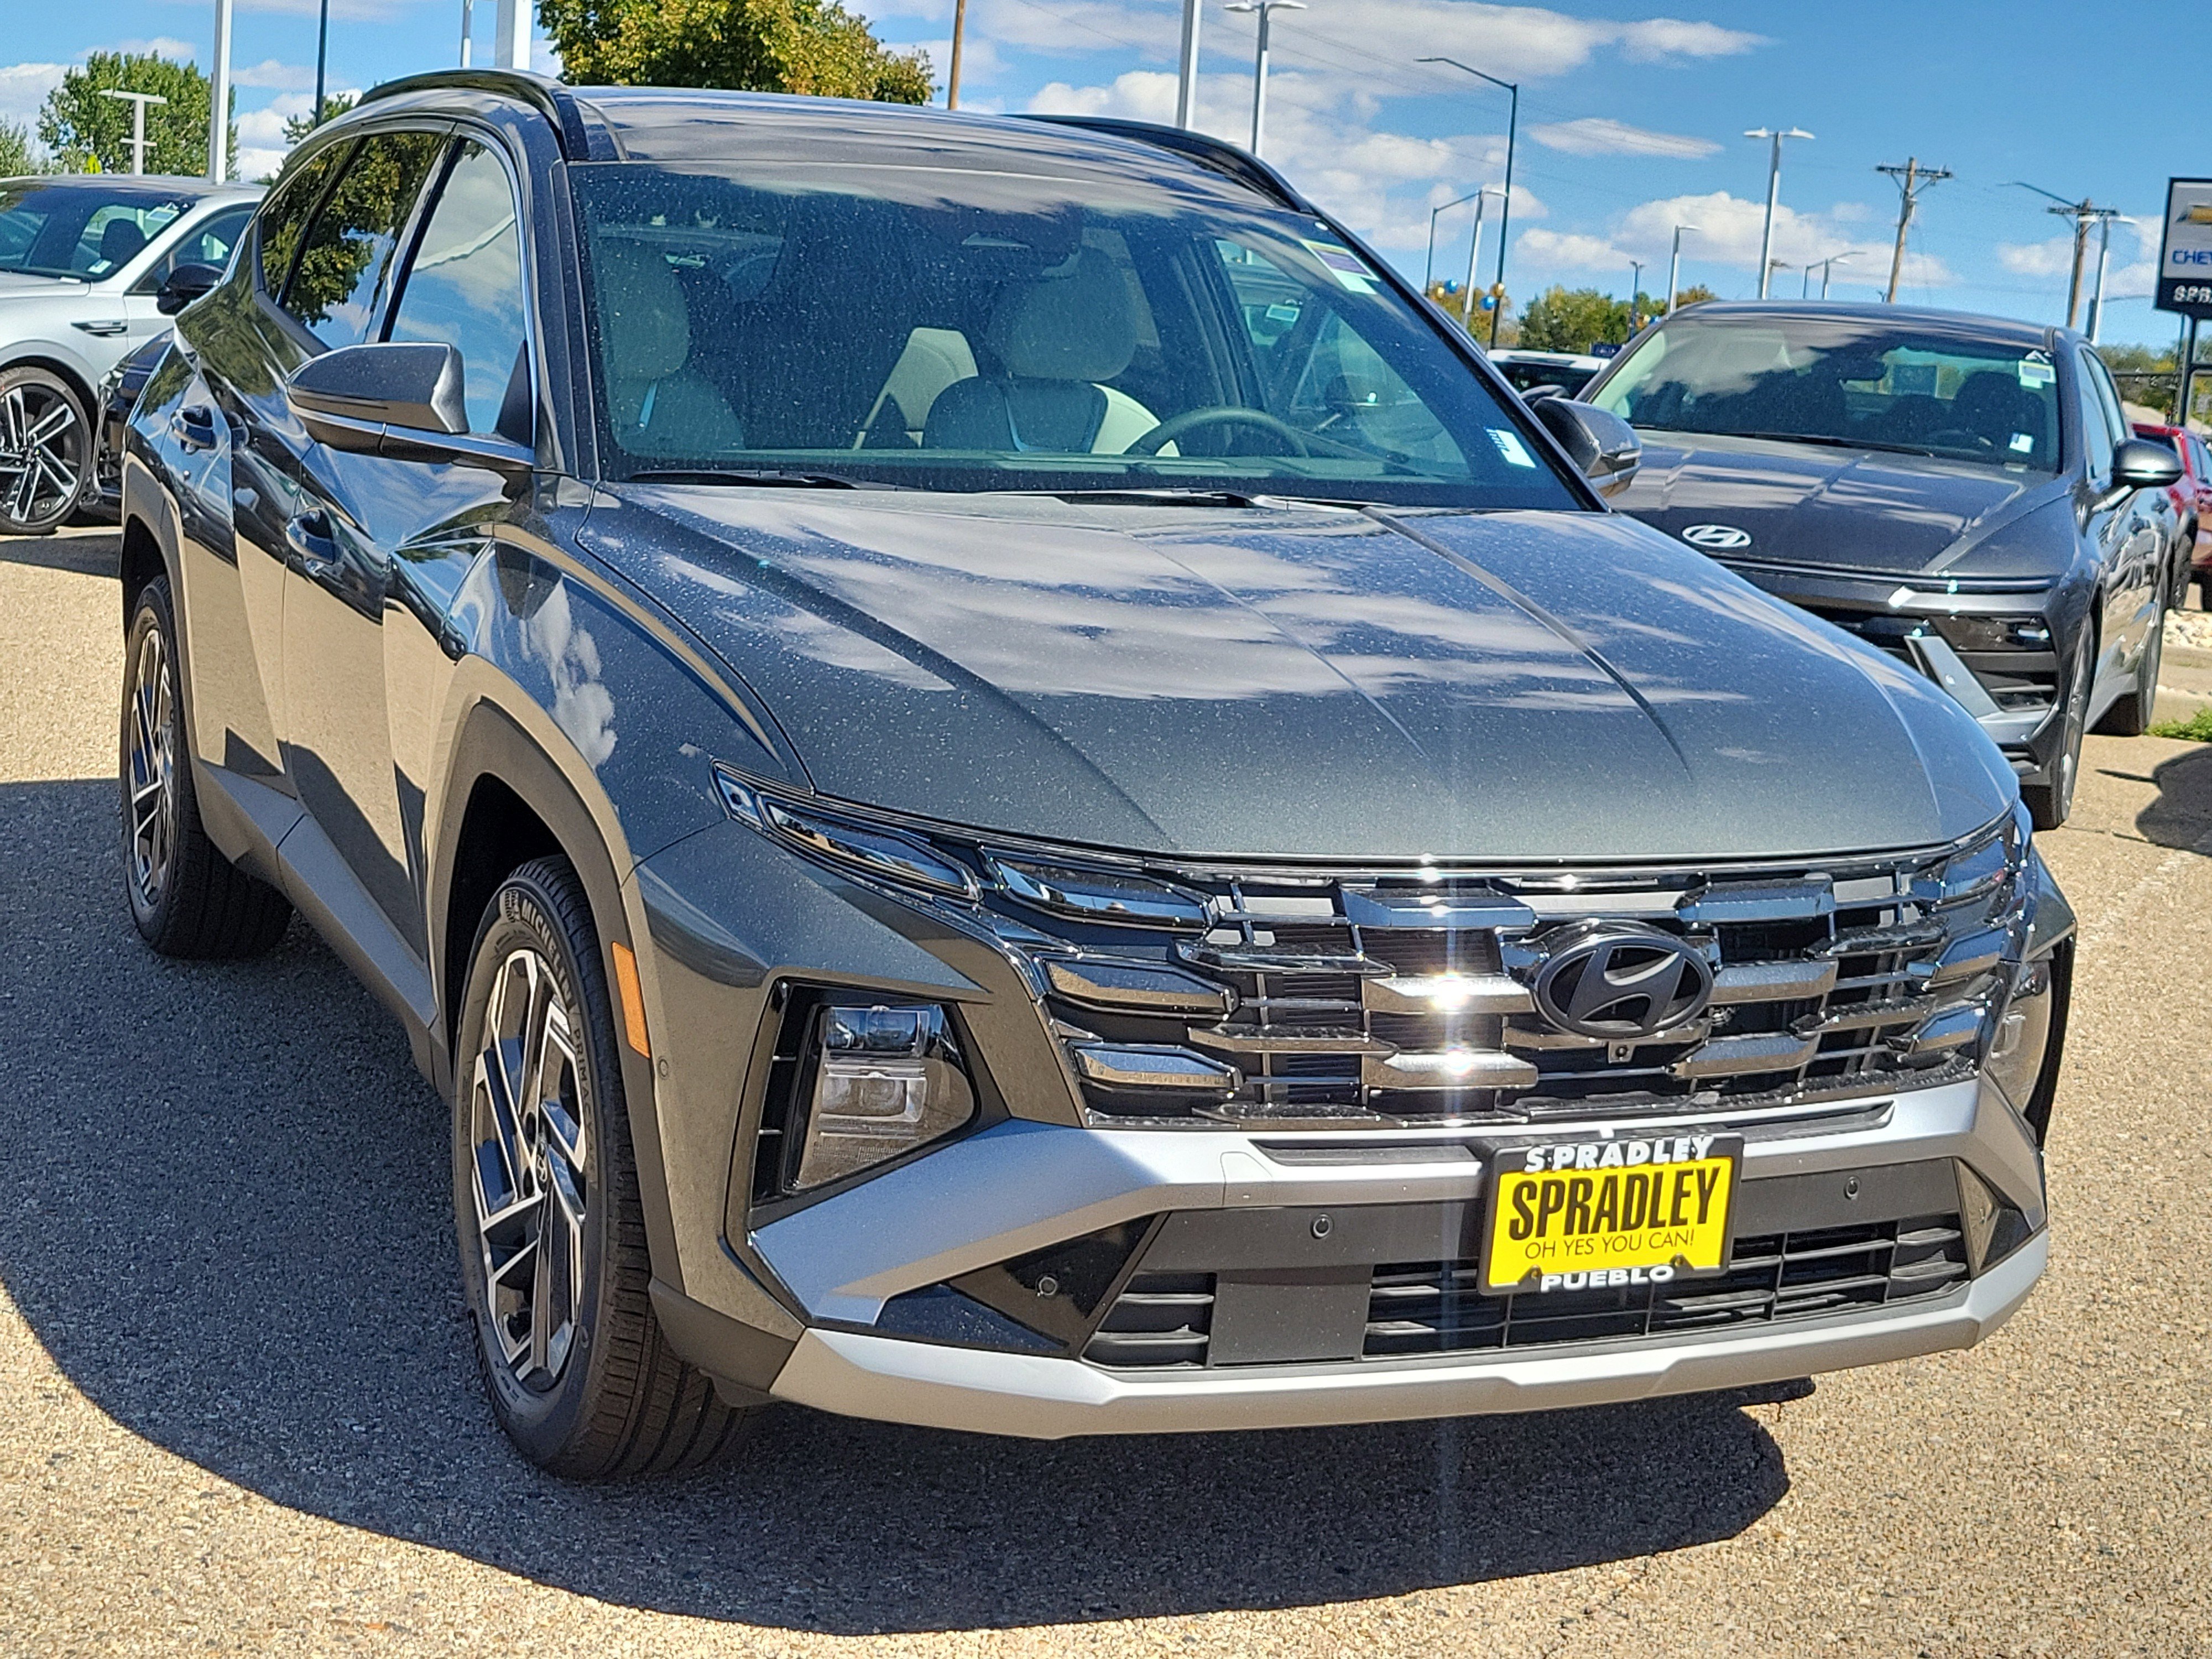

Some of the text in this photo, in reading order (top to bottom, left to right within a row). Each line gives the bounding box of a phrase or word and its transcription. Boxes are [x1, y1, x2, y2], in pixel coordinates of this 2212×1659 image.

[2172, 250, 2212, 264] CHE
[2173, 285, 2212, 304] SPR
[521, 898, 572, 1003] MICHELIN
[1525, 1136, 1714, 1173] SPRADLEY
[1509, 1166, 1721, 1240] SPRADLEY
[1525, 1229, 1694, 1259] OH YES YOU CAN!
[1540, 1265, 1675, 1293] PUEBLO
